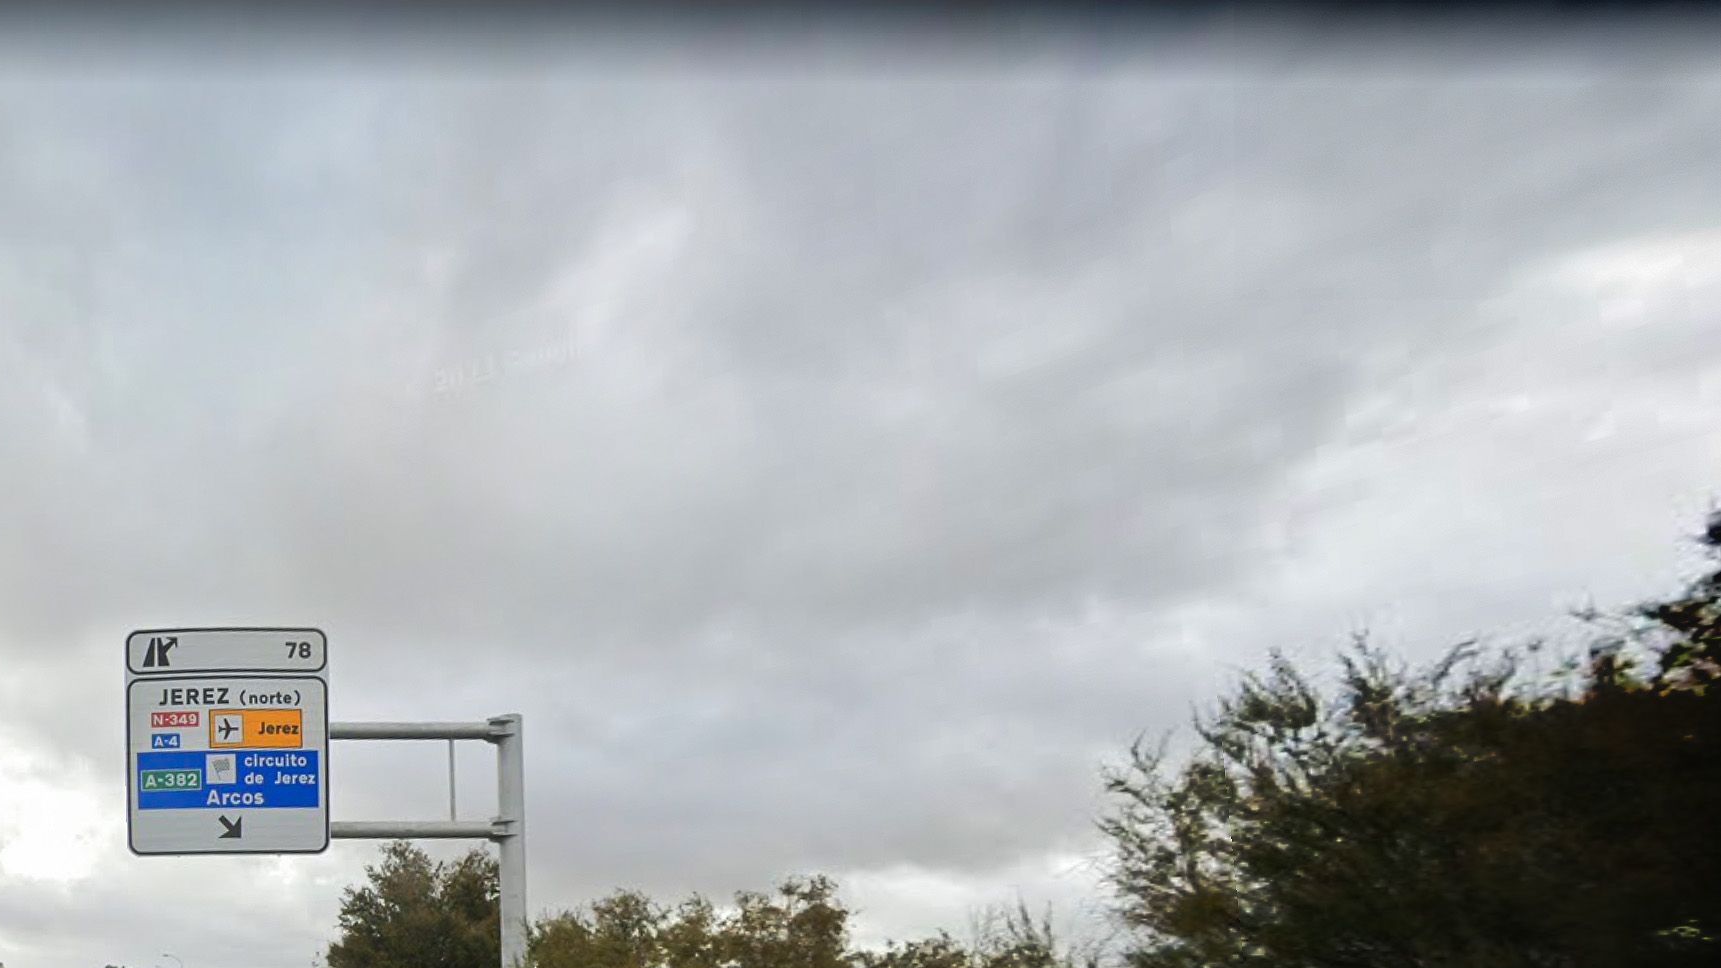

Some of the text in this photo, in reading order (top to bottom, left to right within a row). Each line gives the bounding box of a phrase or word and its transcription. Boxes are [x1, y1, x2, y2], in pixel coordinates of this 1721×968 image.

[285, 641, 312, 659] 78
[159, 688, 301, 706] JEREZ (norte)
[152, 713, 198, 726] N-349
[258, 721, 300, 735] Jerez
[154, 735, 178, 747] A-4
[244, 753, 307, 767] circuito
[145, 773, 198, 788] A-382
[244, 771, 316, 785] de Jerez
[206, 789, 265, 806] Arcos
